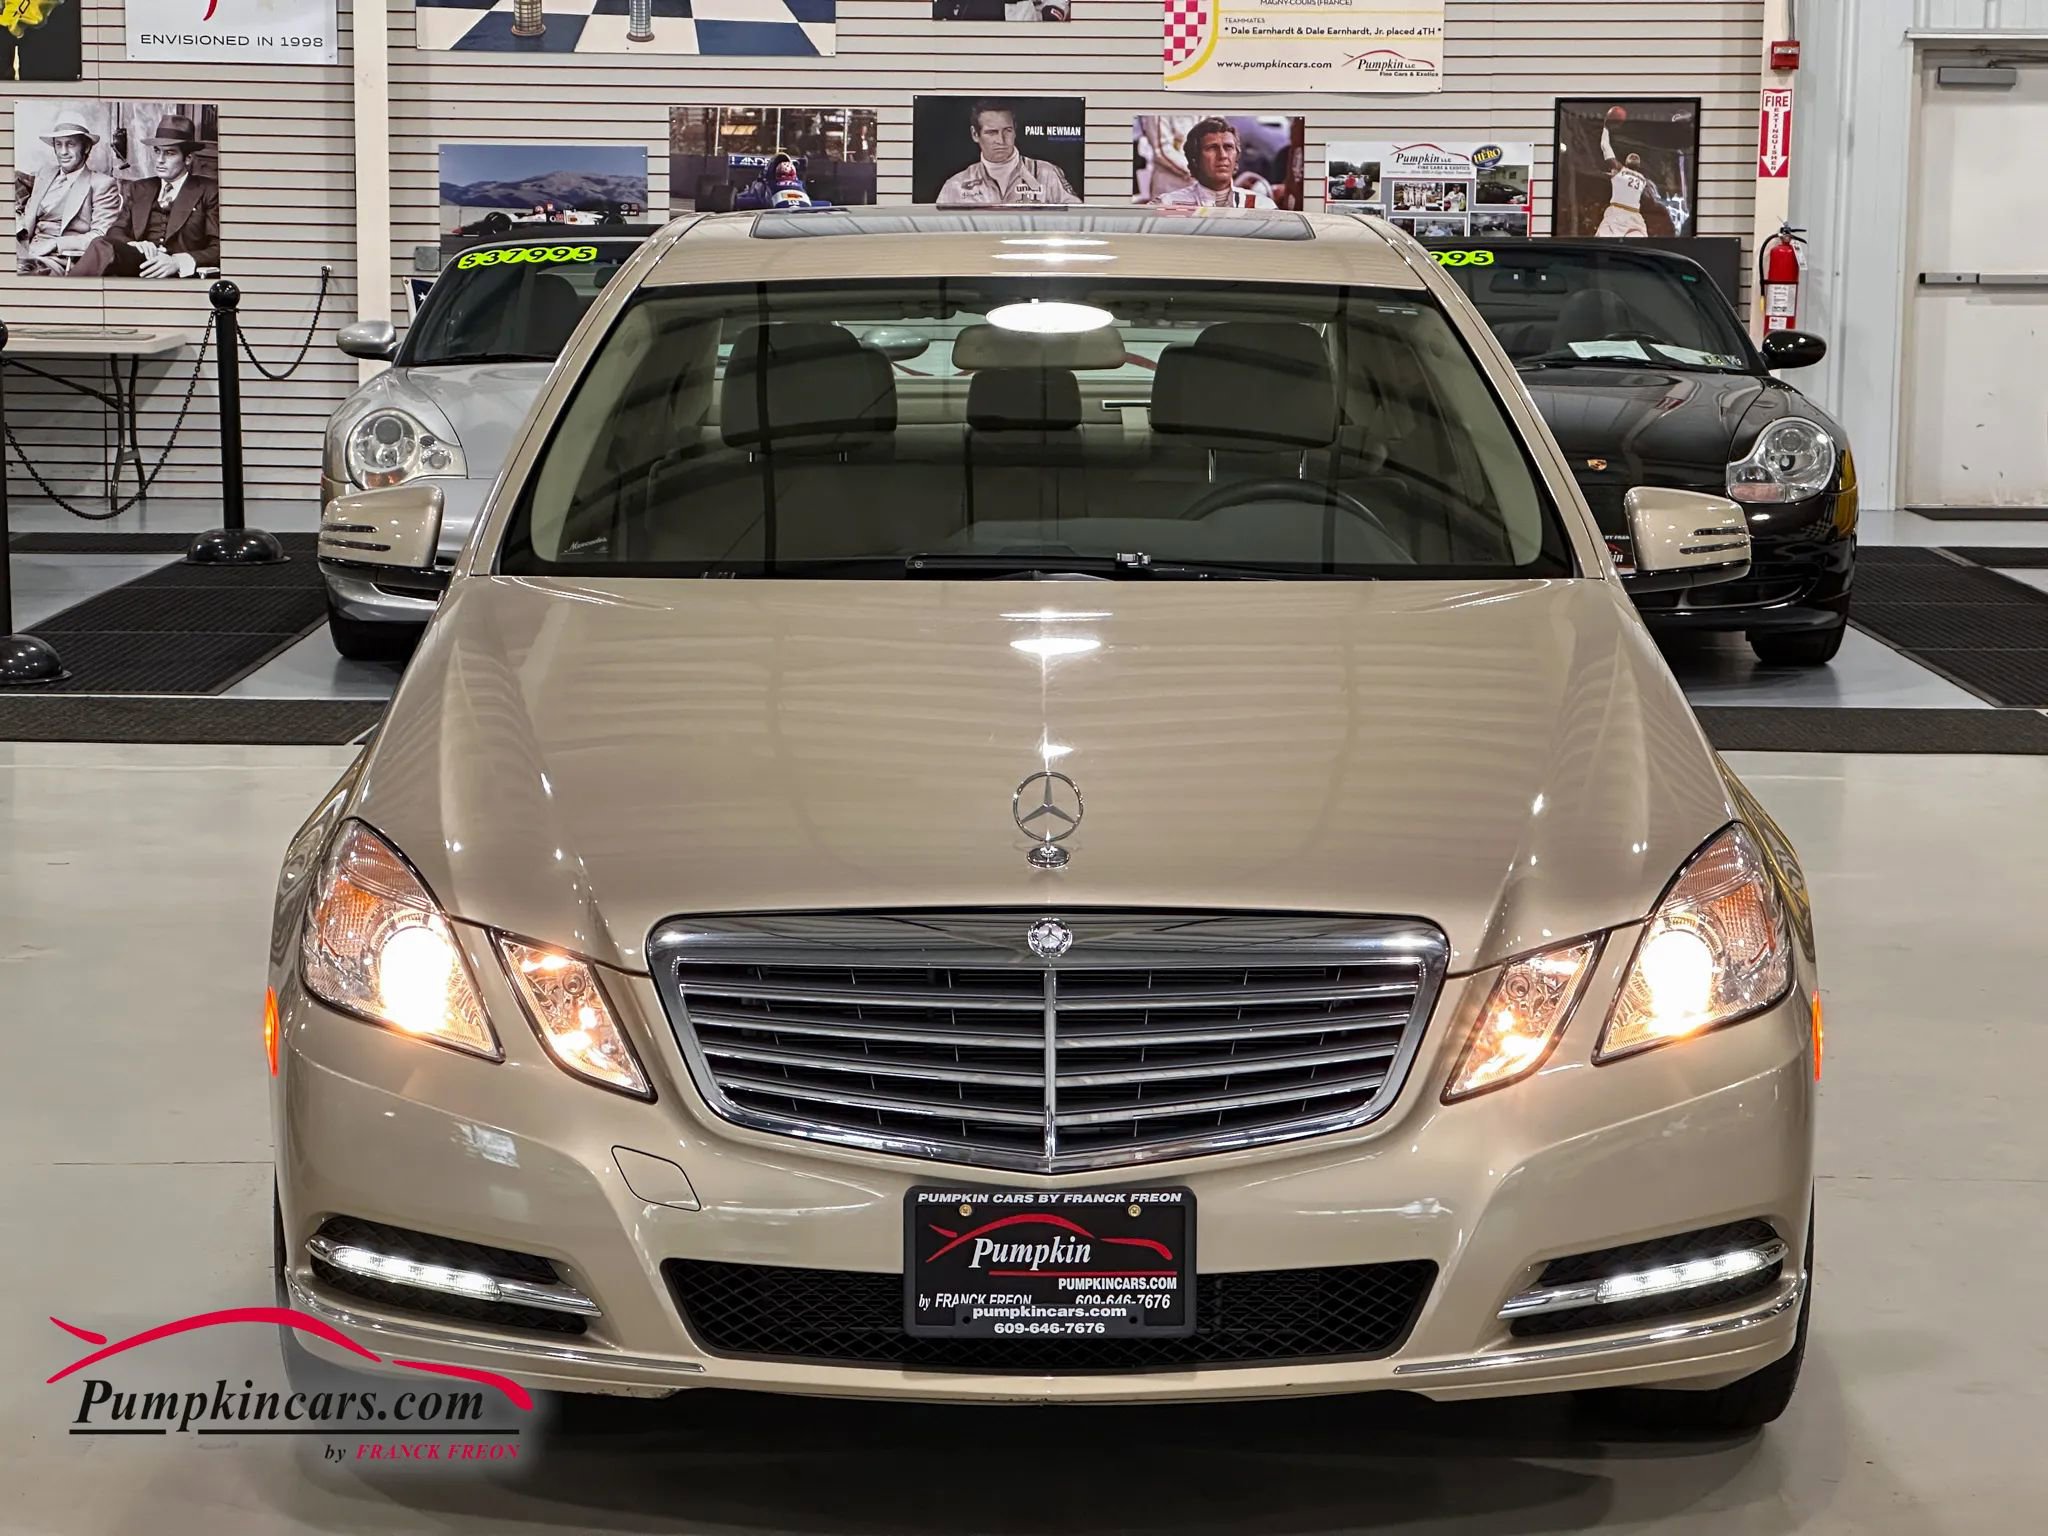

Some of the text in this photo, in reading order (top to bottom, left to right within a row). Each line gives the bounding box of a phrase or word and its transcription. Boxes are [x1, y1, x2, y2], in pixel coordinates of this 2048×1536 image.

[1231, 27, 1250, 35] Dale
[1252, 27, 1295, 35] Earnhardt
[1296, 27, 1303, 35] &
[1305, 27, 1325, 35] Dale
[1327, 27, 1372, 36] Earnhardt,
[1386, 27, 1415, 36] placed
[1416, 28, 1436, 36] 4TH
[140, 34, 324, 48] ENVISIONED IN 1998
[1216, 59, 1332, 71] www.pumpkincars.com
[1357, 59, 1404, 72] Pumpkin
[1765, 96, 1789, 107] FIRE
[1024, 125, 1082, 137] PAUL NEWMAN
[1770, 107, 1780, 171] EXTINGUISHER
[1396, 153, 1439, 165] Pumpkin
[1473, 147, 1501, 164] HERO
[1627, 177, 1640, 190] 23
[462, 247, 594, 267] $37995
[917, 1192, 1182, 1203] PUMPKIN CARS BY FRANCK FREON
[967, 1235, 1092, 1271] Pumpkin
[1058, 1277, 1177, 1290] PUMPKINCARS.COM
[918, 1294, 931, 1311] by
[934, 1293, 987, 1308] FRANCK
[1075, 1294, 1171, 1309] 609-646-7676
[972, 1305, 1127, 1319] pumpkincars.com
[994, 1322, 1106, 1334] 609-646-7676
